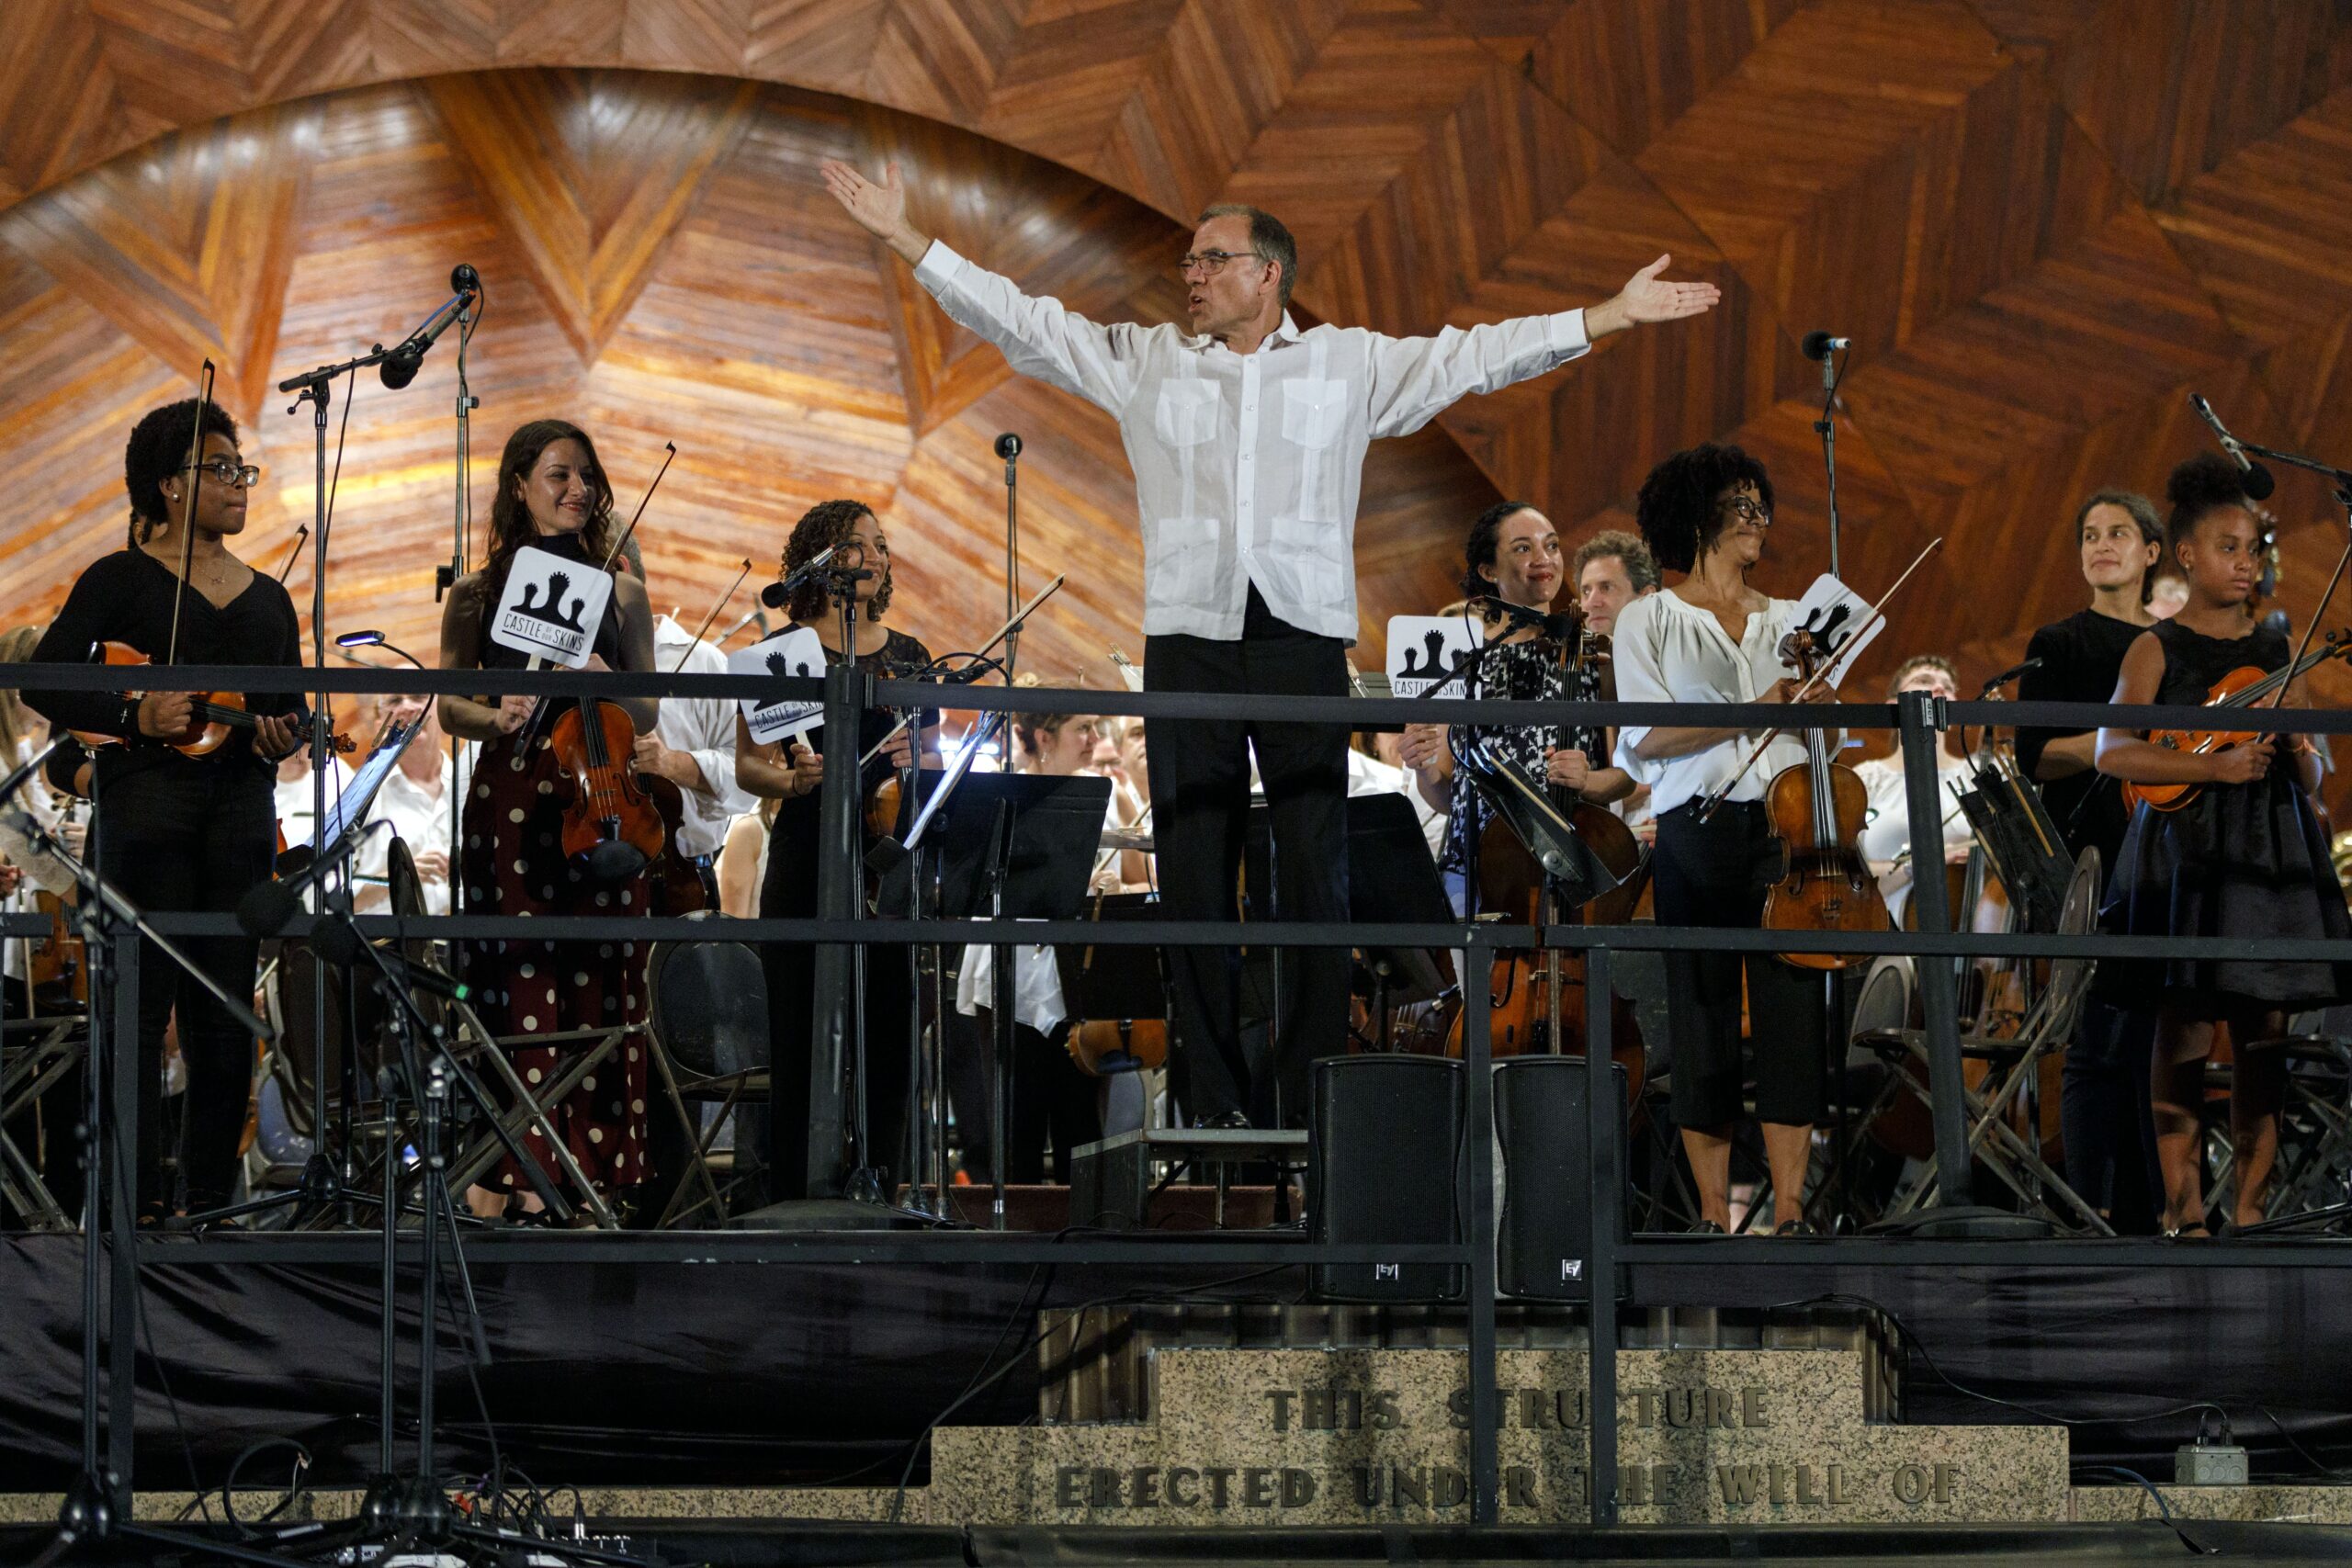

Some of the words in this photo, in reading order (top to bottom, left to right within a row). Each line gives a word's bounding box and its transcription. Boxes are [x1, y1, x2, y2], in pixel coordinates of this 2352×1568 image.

[503, 613, 543, 637] CASTLE
[552, 629, 584, 651] SKINS
[1442, 682, 1465, 696] SKIN
[754, 705, 789, 728] CASTLE
[800, 701, 825, 713] SKI
[1566, 1262, 1579, 1277] EV
[1264, 1389, 1401, 1430] THIS
[1448, 1388, 1770, 1429] STRUTURE
[1056, 1467, 1315, 1508] ERECTED
[1351, 1466, 1540, 1507] UNDR
[1717, 1464, 1852, 1505] WILL
[1893, 1463, 1960, 1505] OF
